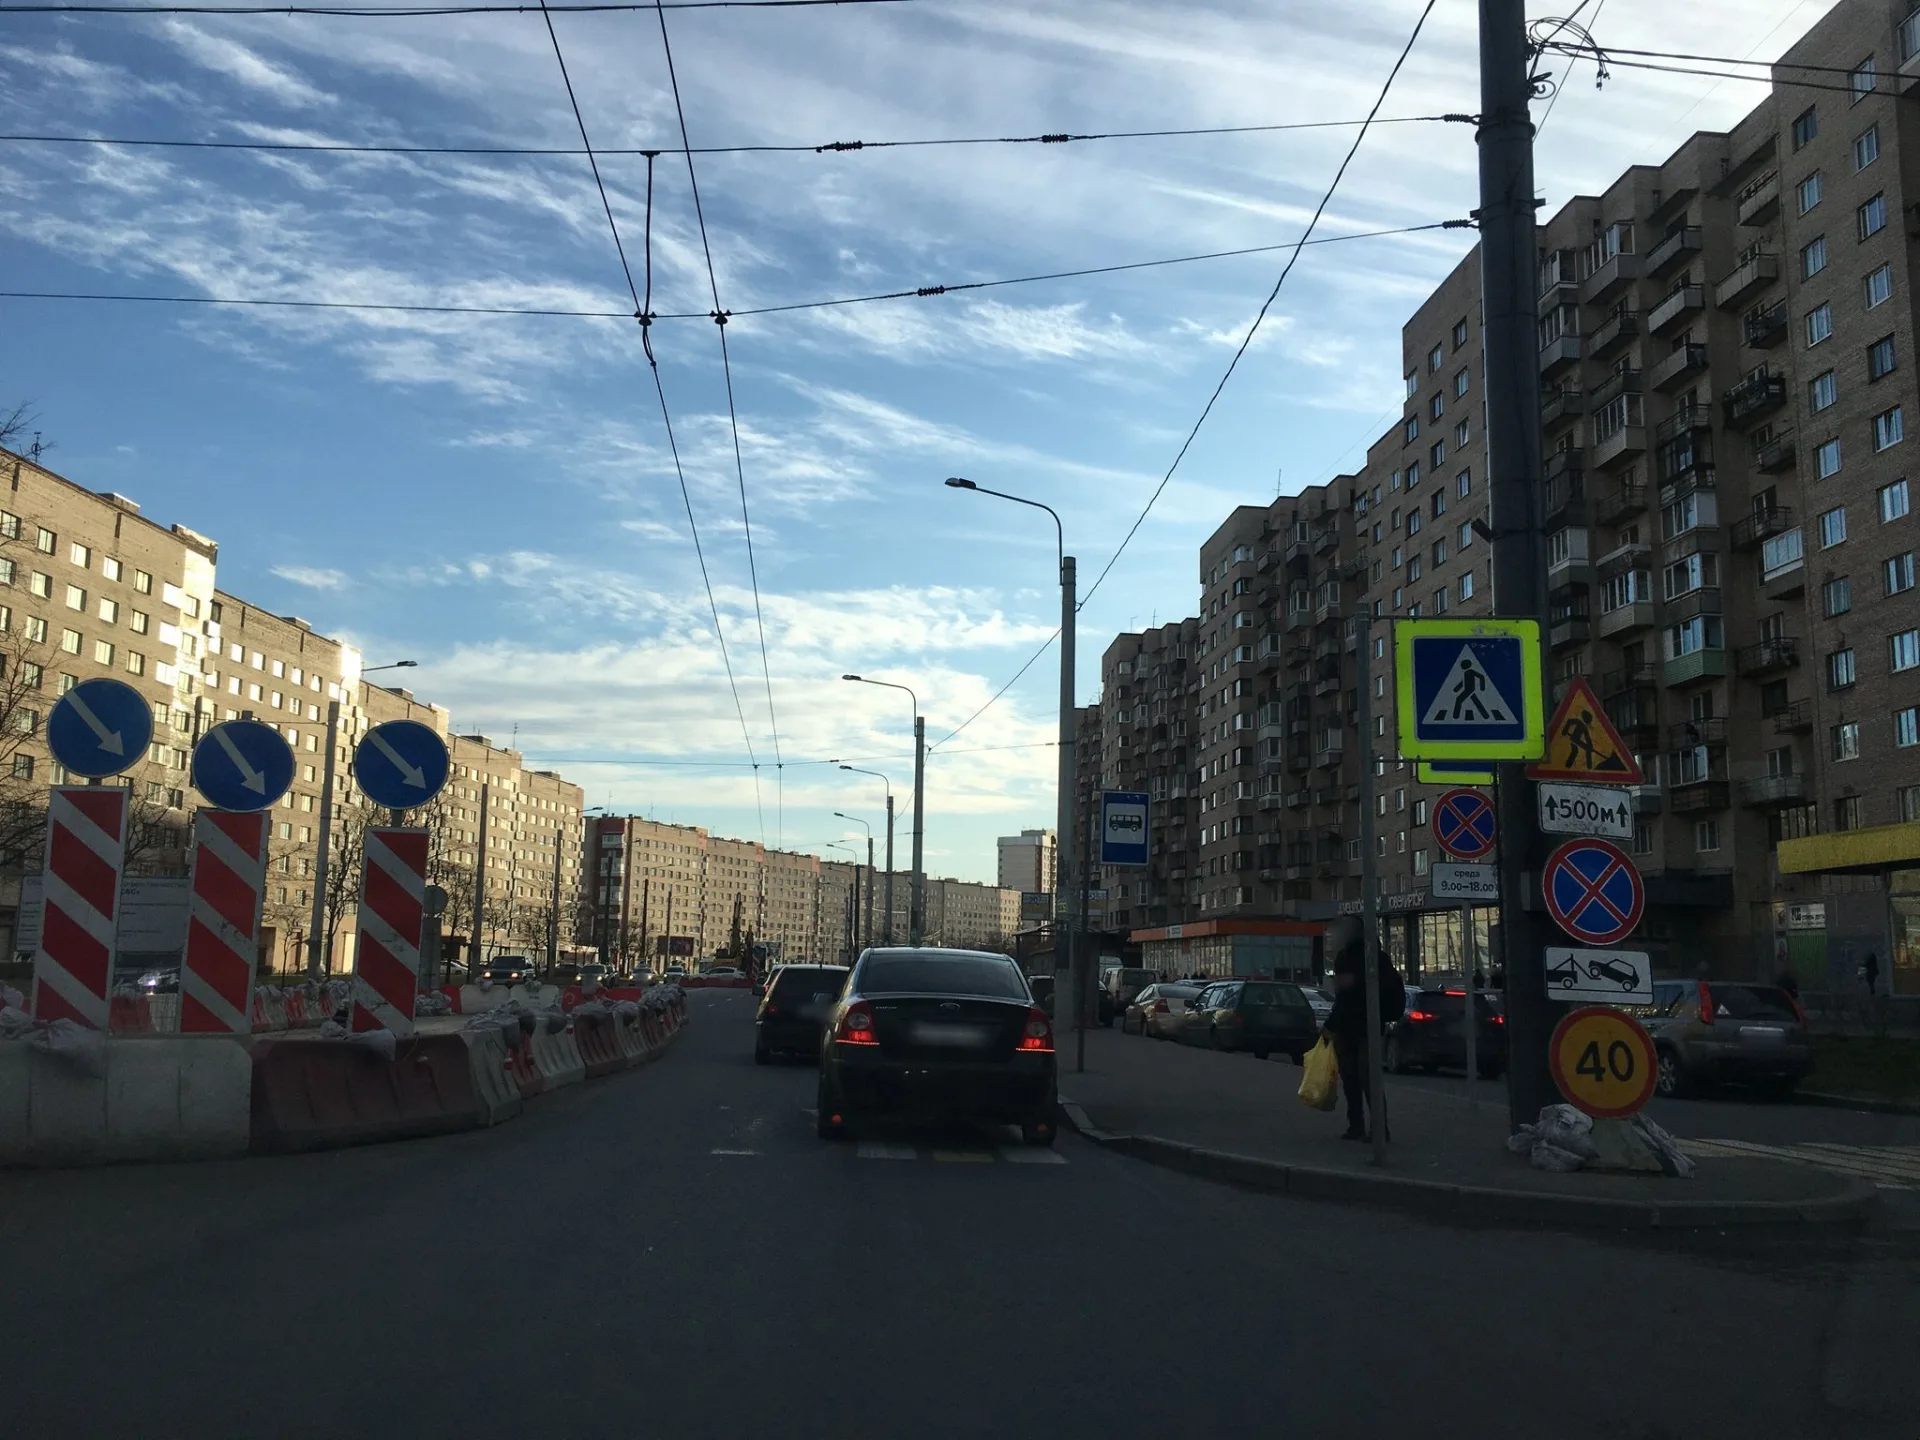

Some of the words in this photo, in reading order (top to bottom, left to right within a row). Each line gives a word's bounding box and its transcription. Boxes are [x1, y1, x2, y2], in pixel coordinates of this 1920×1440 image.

[1559, 799, 1615, 823] 500м
[1454, 870, 1481, 879] среда
[1575, 1039, 1635, 1082] 40
